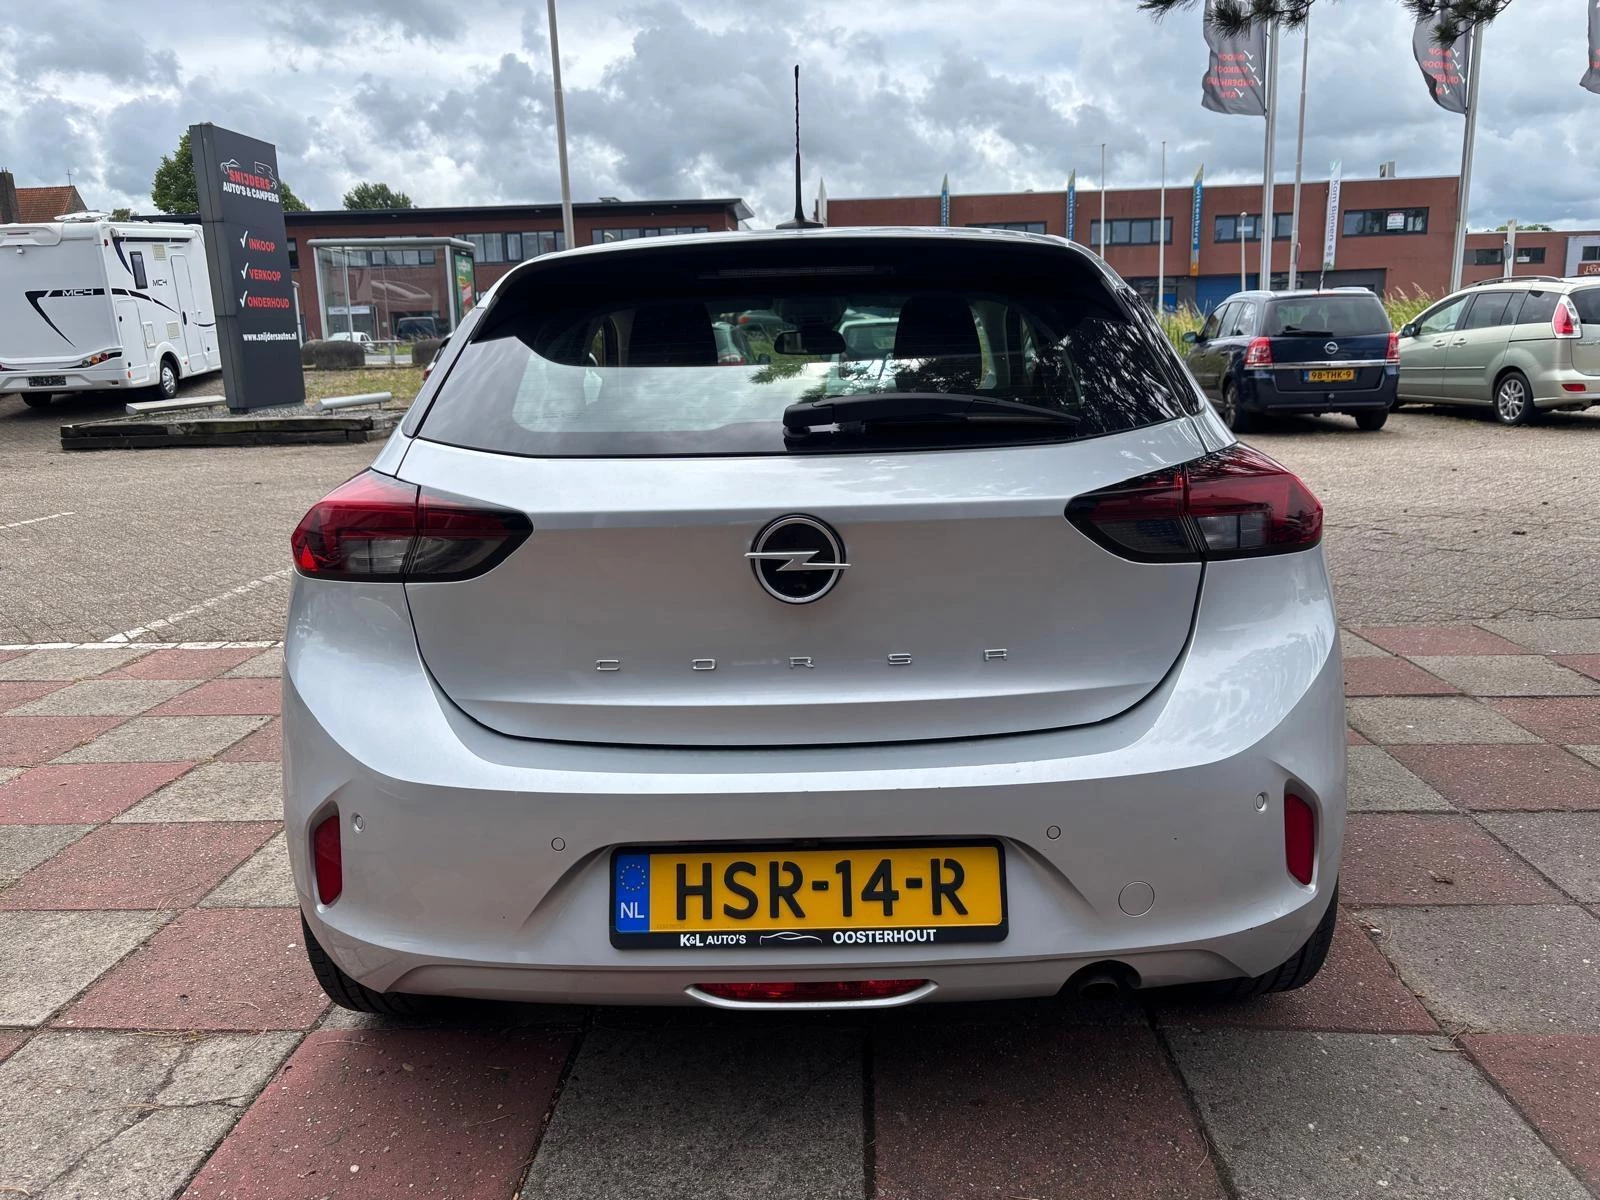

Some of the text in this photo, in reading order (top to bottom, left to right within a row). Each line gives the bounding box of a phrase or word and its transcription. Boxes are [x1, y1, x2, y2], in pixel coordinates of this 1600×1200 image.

[228, 168, 271, 191] SNIJDERS
[223, 182, 279, 203] AUTO'S & CAMPERS
[248, 238, 275, 252] INKOOP
[249, 268, 281, 281] VERKOOP
[152, 279, 168, 287] MC4
[248, 297, 289, 308] ONDERHOUD
[243, 331, 297, 342] www.snijdersautos.nl
[596, 648, 1008, 671] CORSA
[676, 858, 970, 921] HSR-14-R
[620, 901, 645, 919] NL
[680, 933, 747, 946] K&L AUTO'S
[832, 929, 937, 944] OOSTERHOUT
